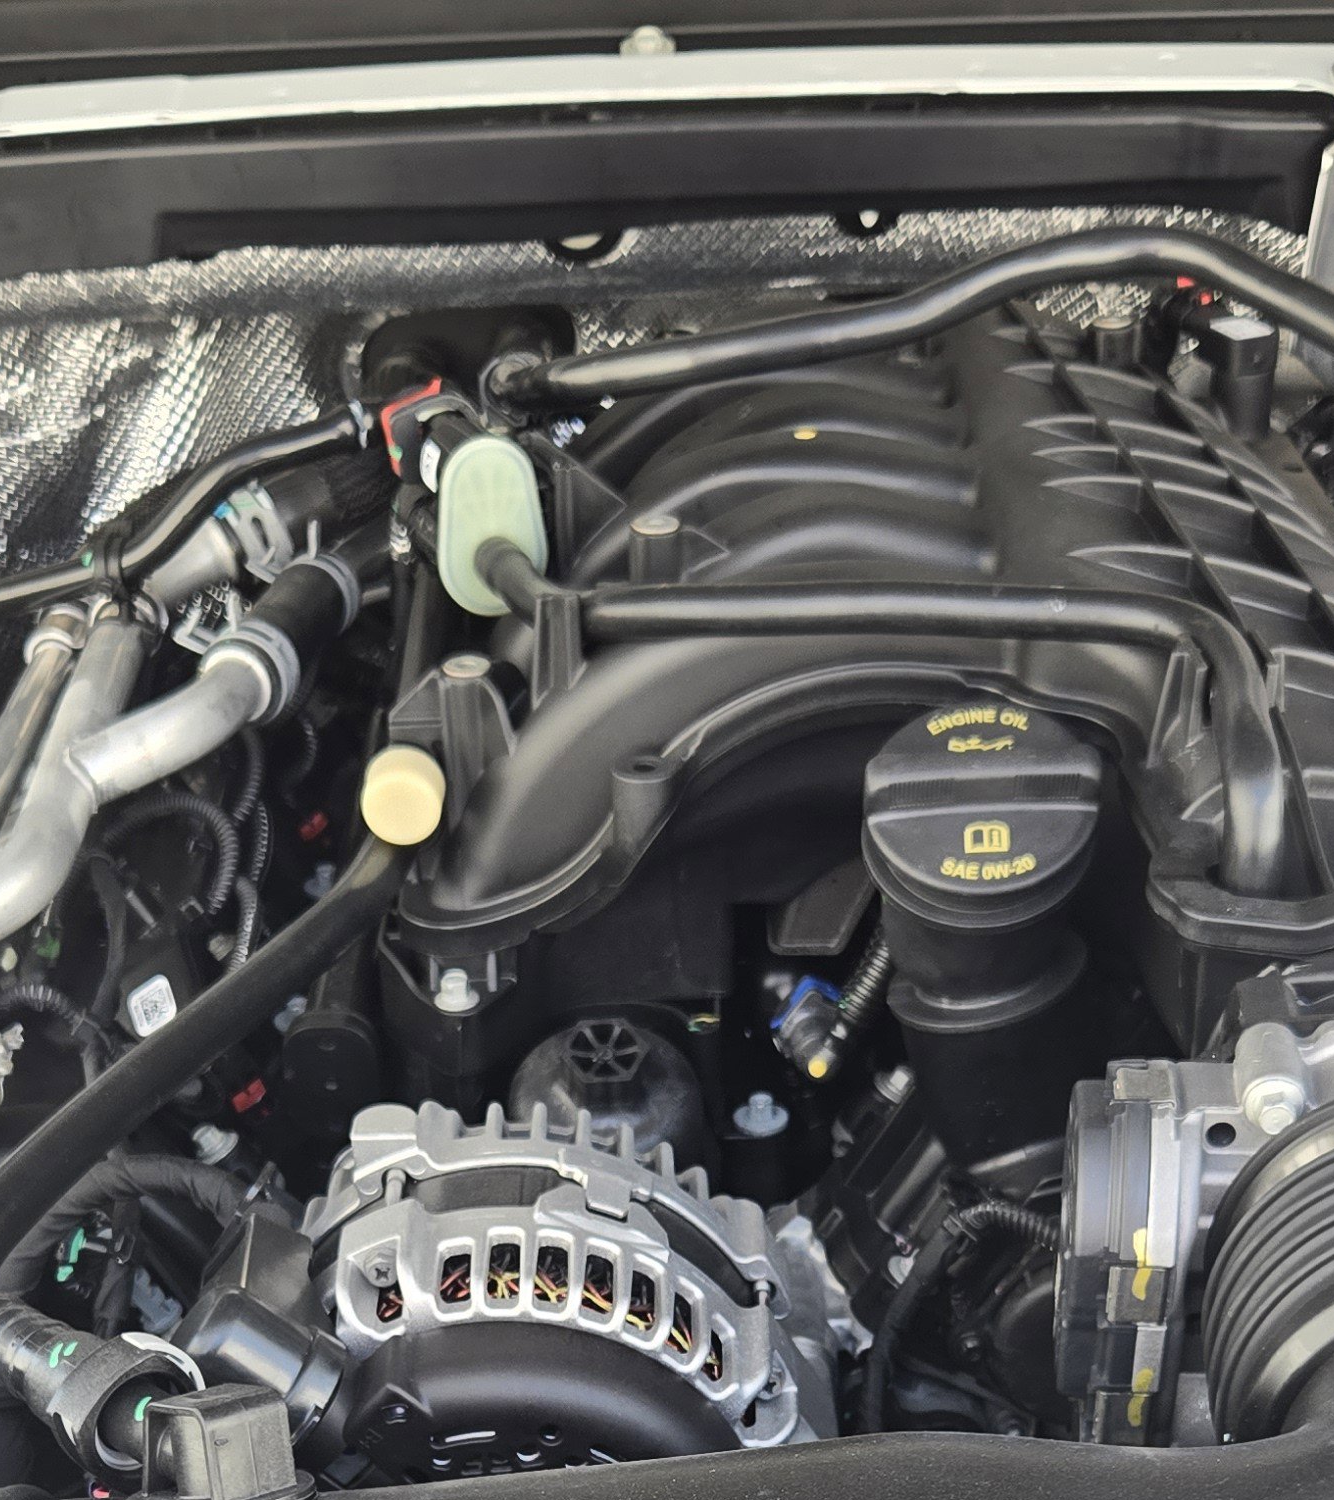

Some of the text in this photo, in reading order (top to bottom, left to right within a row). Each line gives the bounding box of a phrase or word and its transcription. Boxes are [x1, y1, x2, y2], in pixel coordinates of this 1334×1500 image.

[926, 708, 1030, 737] ENGINE OIL
[940, 852, 1037, 881] SAE 0W-20
